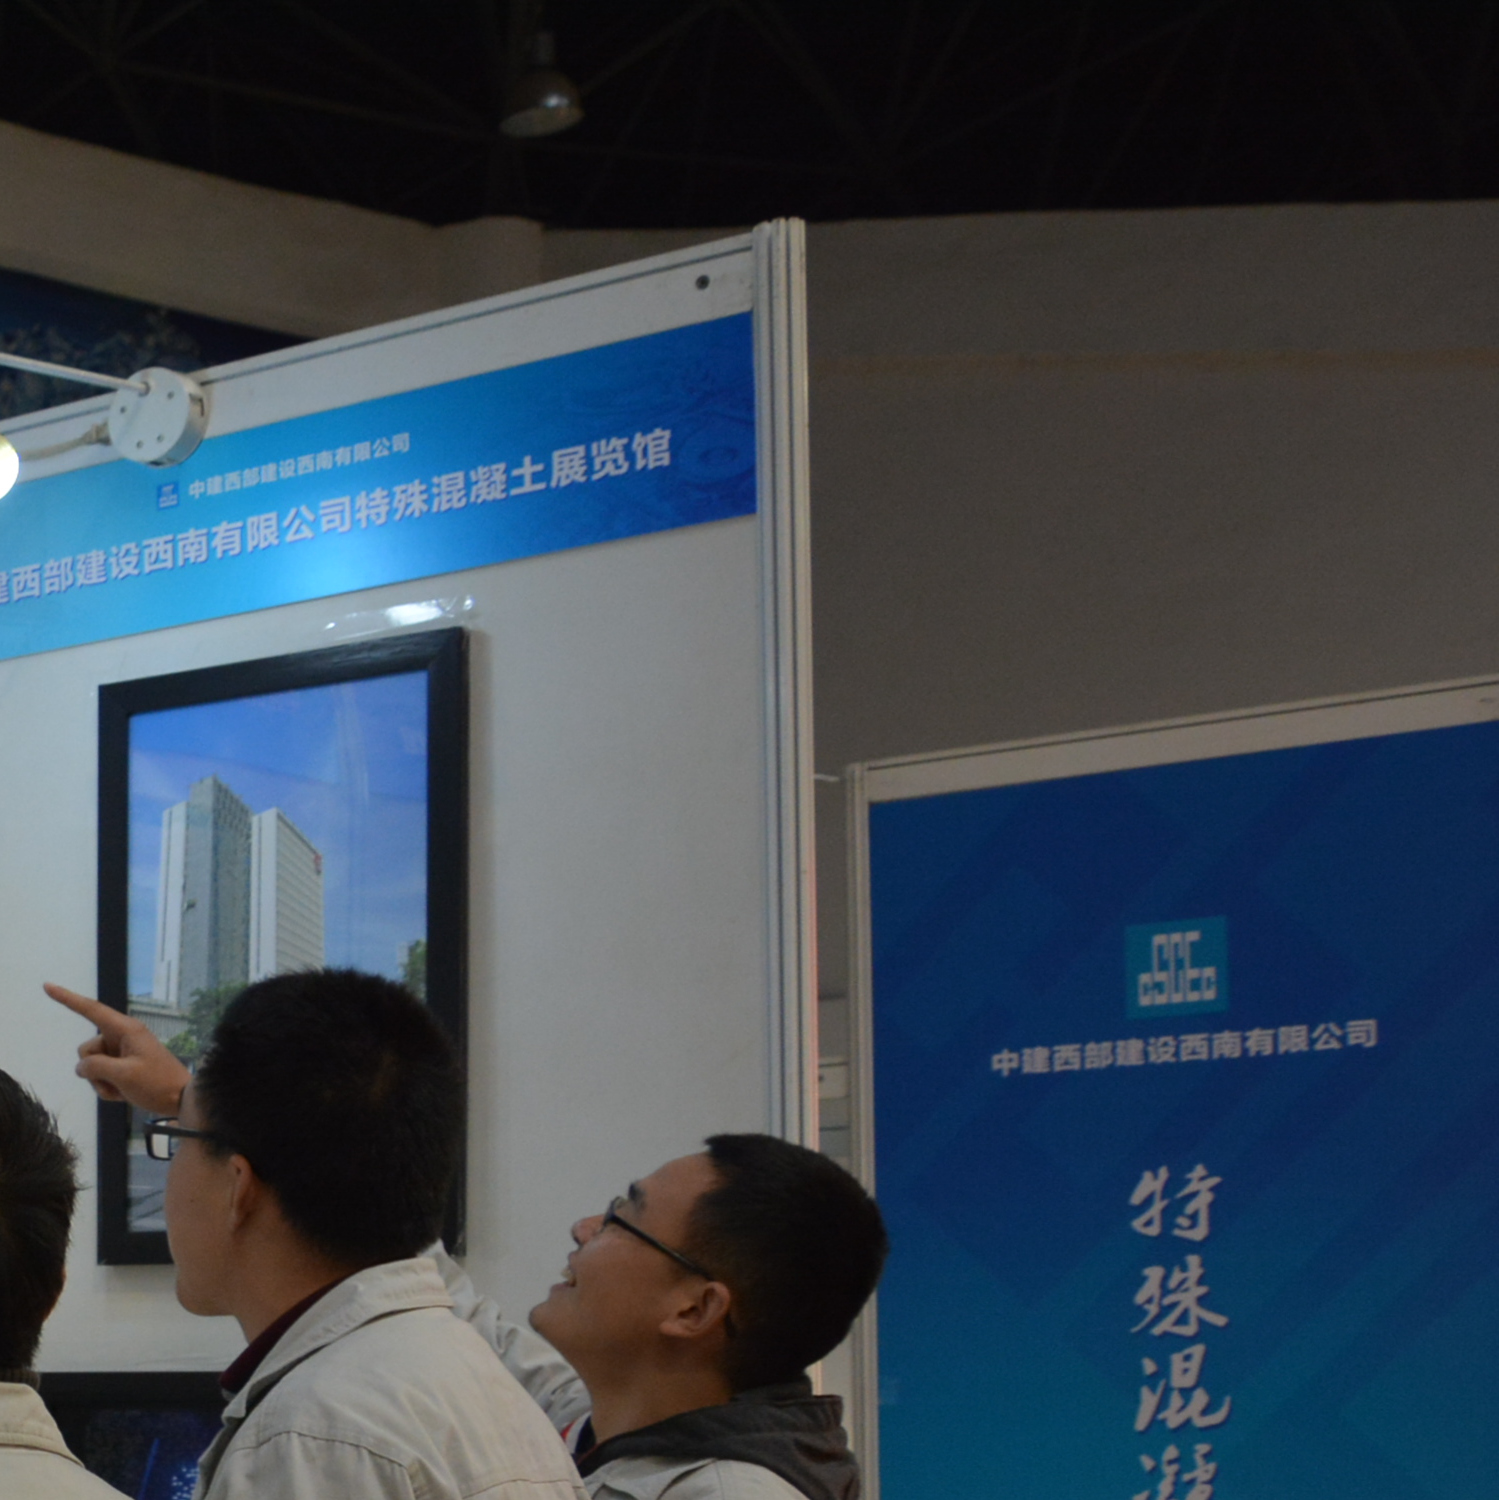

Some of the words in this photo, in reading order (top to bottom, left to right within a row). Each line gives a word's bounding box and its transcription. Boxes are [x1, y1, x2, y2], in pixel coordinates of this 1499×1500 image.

[189, 431, 411, 499] 中建西部建设西南有限公司
[991, 1018, 1379, 1078] 中建西部建设西南有限公司
